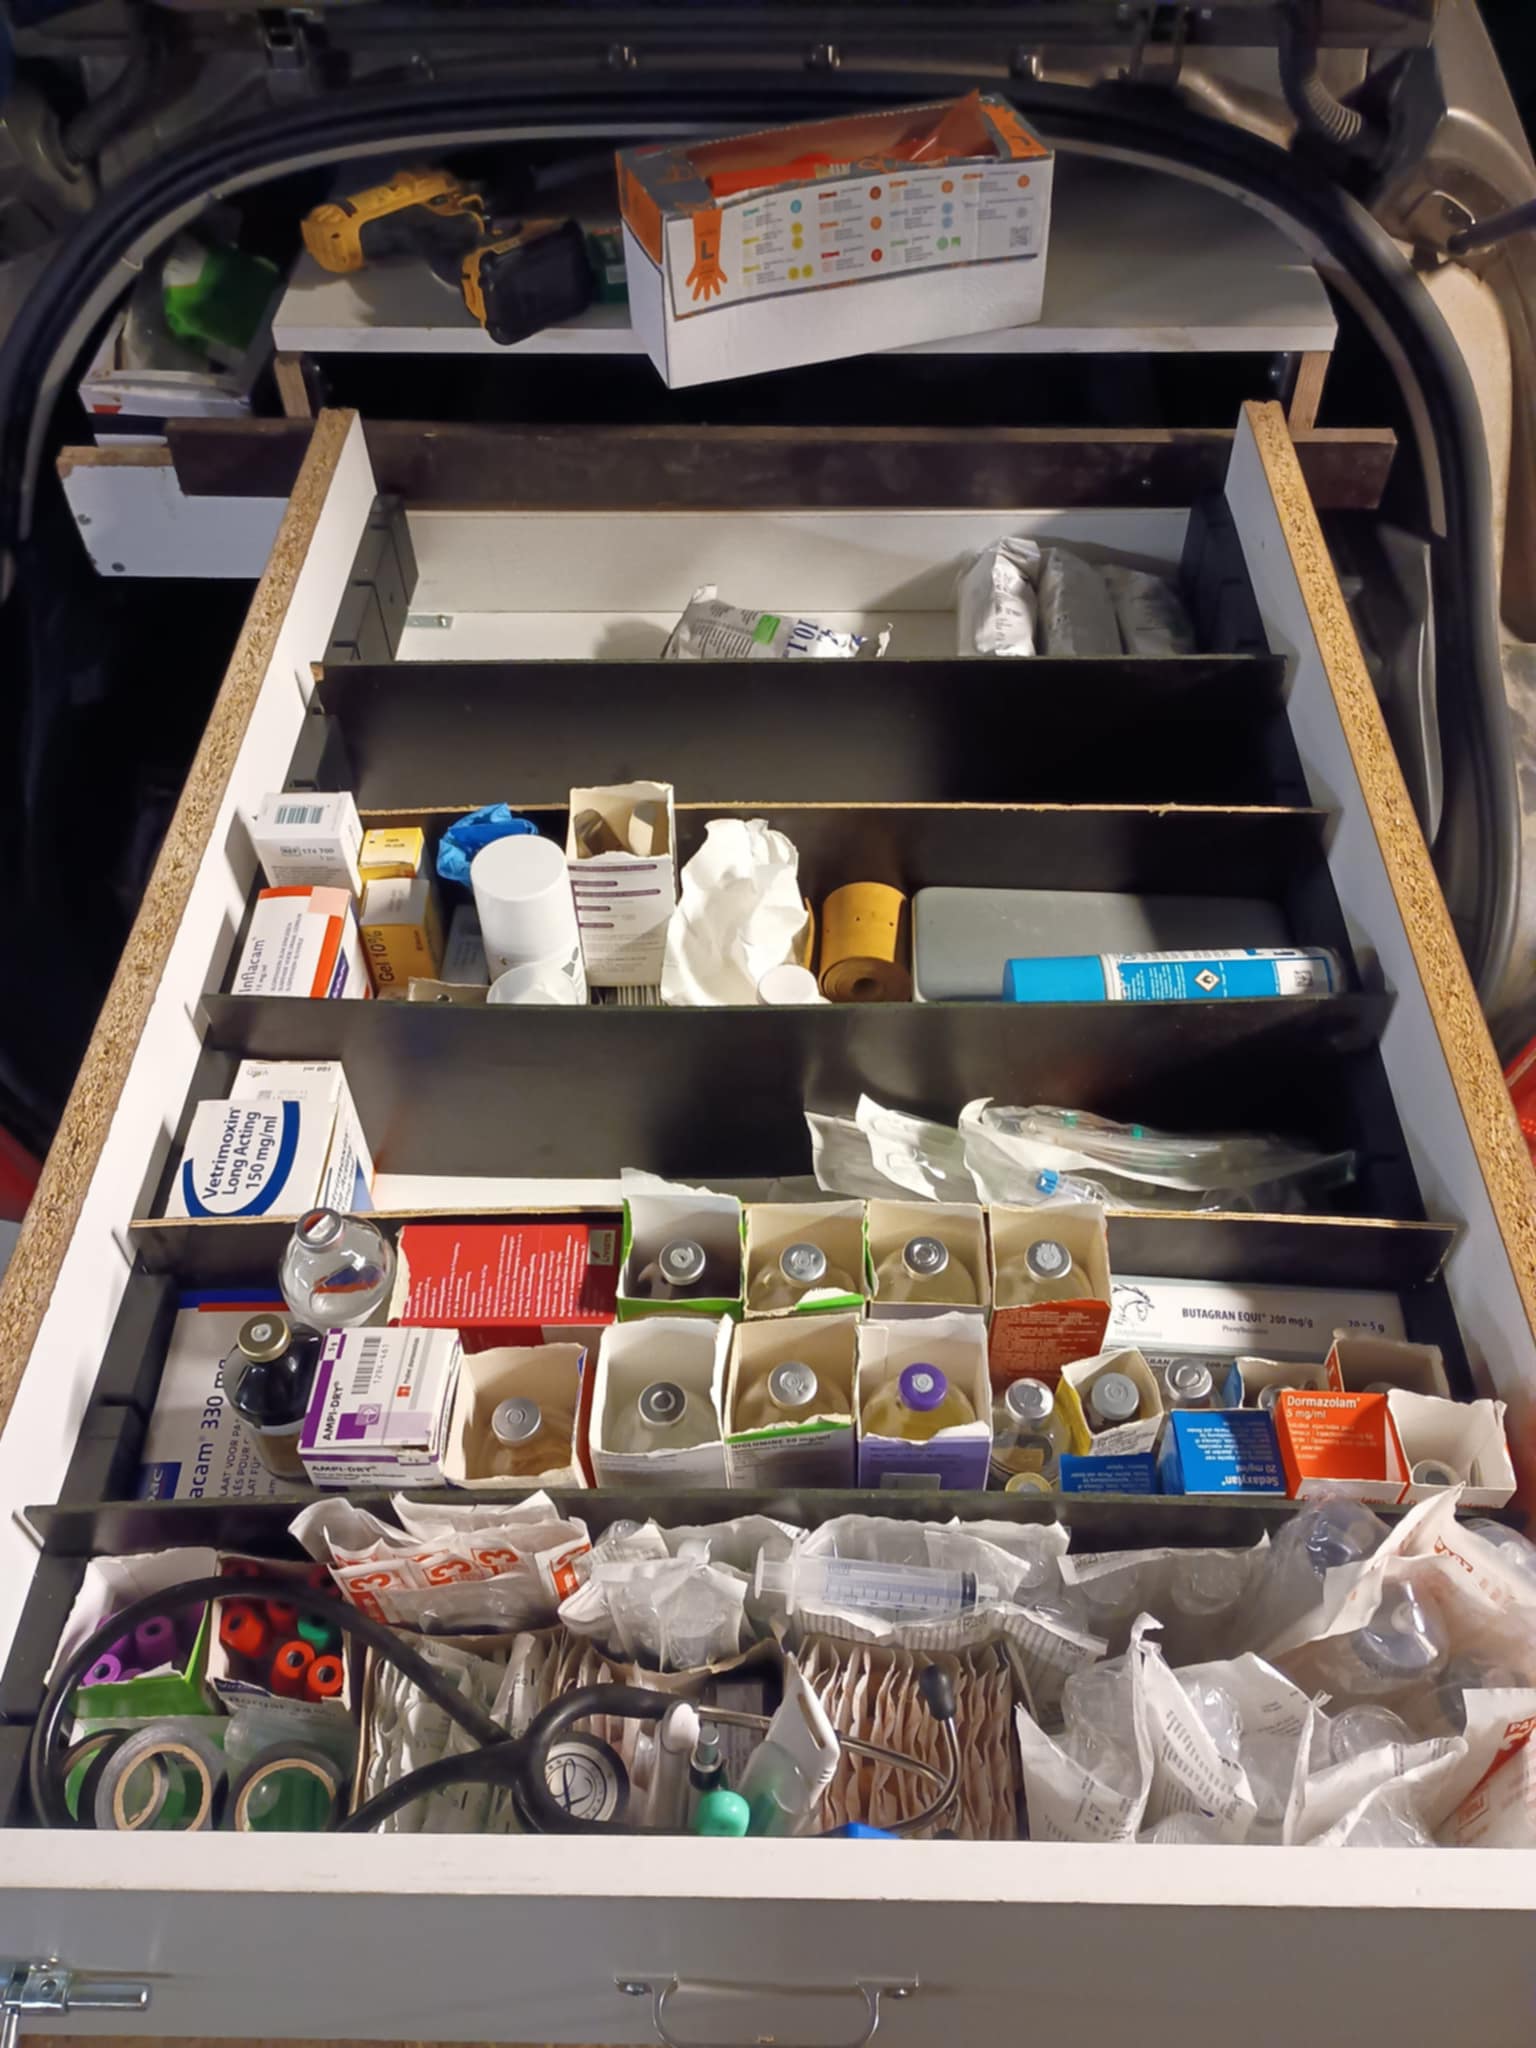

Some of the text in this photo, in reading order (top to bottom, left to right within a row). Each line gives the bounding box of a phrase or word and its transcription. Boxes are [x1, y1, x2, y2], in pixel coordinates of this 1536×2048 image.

[700, 239, 715, 261] L
[365, 929, 396, 983] Gel 10%
[201, 1107, 242, 1200] Vetrimoxin
[222, 1111, 262, 1195] Long Acting
[245, 1116, 279, 1190] 150 mg/ml
[1181, 1307, 1237, 1321] BUTAGRAN
[1237, 1311, 1263, 1323] EQUI
[1288, 1316, 1314, 1329] mg/g
[200, 1395, 225, 1430] 330
[1286, 1394, 1358, 1409] Dormazolam
[232, 1418, 241, 1437] PA
[226, 1440, 239, 1469] VOOR
[237, 1447, 250, 1476] POUR
[188, 1441, 214, 1500] acam
[1222, 1474, 1280, 1487] Sedaxylan
